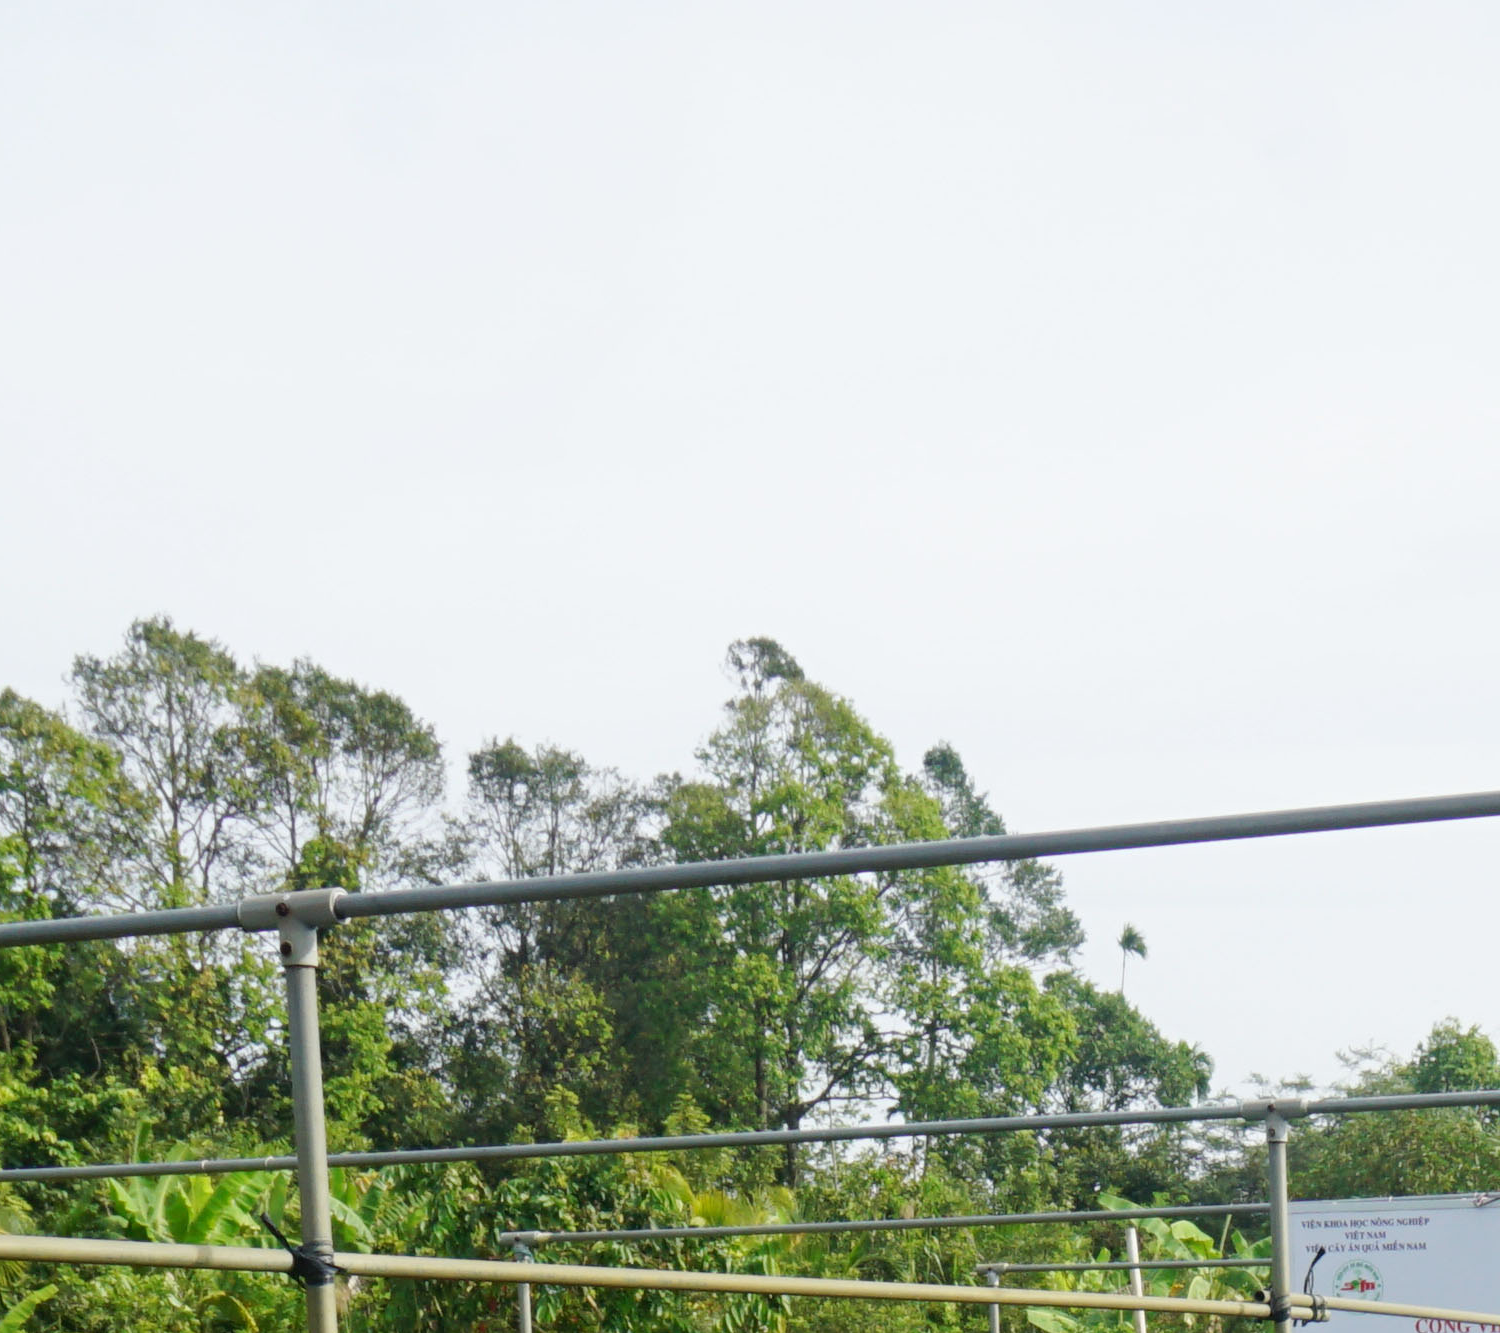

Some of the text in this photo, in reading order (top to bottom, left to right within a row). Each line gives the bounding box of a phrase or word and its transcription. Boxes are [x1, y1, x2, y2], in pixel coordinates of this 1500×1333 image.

[1324, 1219, 1348, 1228] KHOA
[1350, 1218, 1369, 1229] HỌC
[1370, 1216, 1394, 1227] NÔNG
[1396, 1215, 1430, 1226] NGHIỆP
[1367, 1231, 1386, 1240] NAM
[1406, 1242, 1427, 1251] NAM
